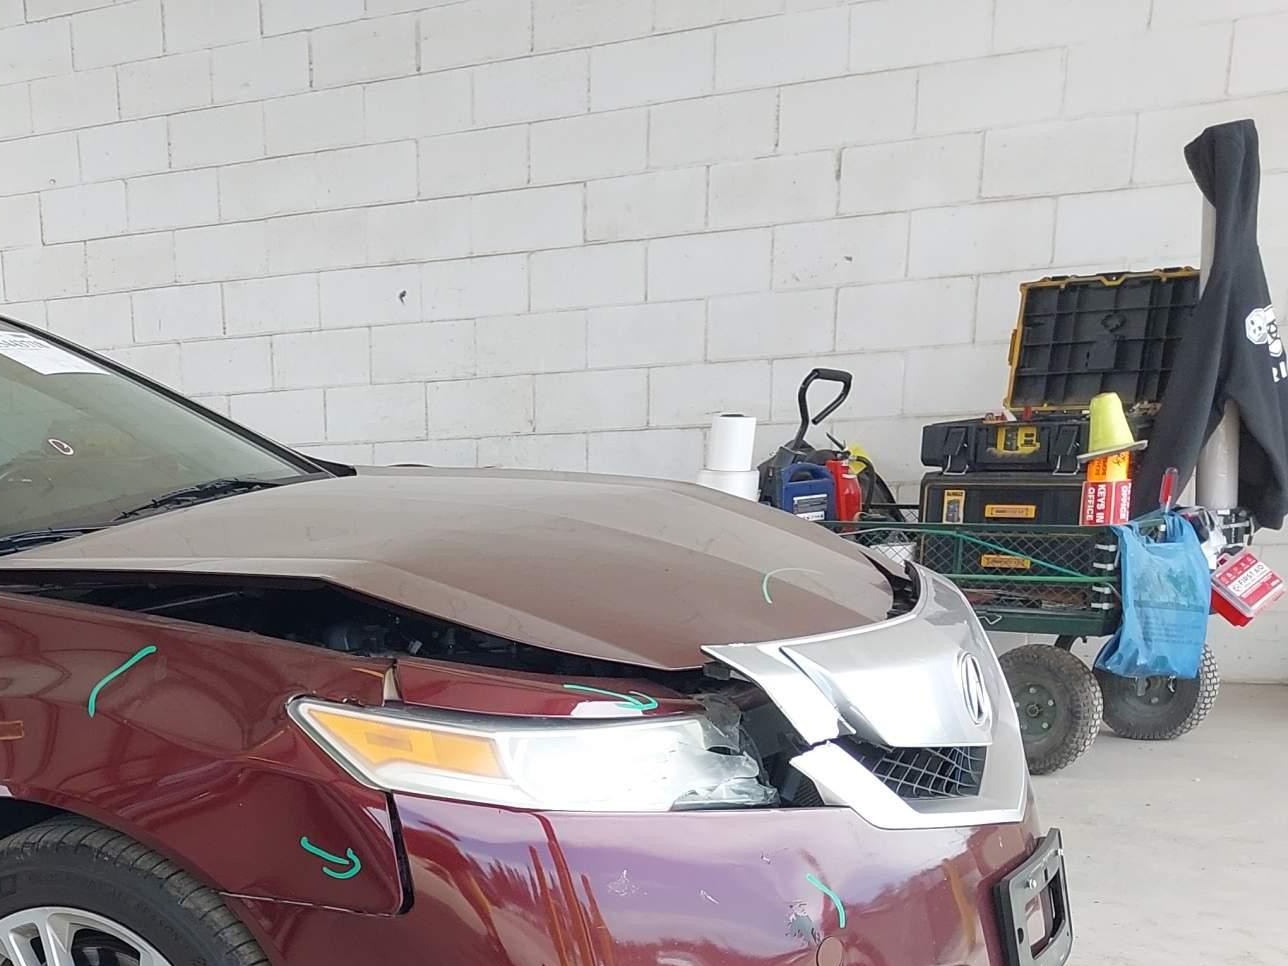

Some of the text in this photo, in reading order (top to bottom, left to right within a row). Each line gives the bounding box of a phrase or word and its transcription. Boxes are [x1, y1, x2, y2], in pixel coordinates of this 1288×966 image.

[1086, 486, 1096, 521] OFFICE
[1096, 484, 1107, 511] KEYS
[1095, 512, 1105, 524] IN
